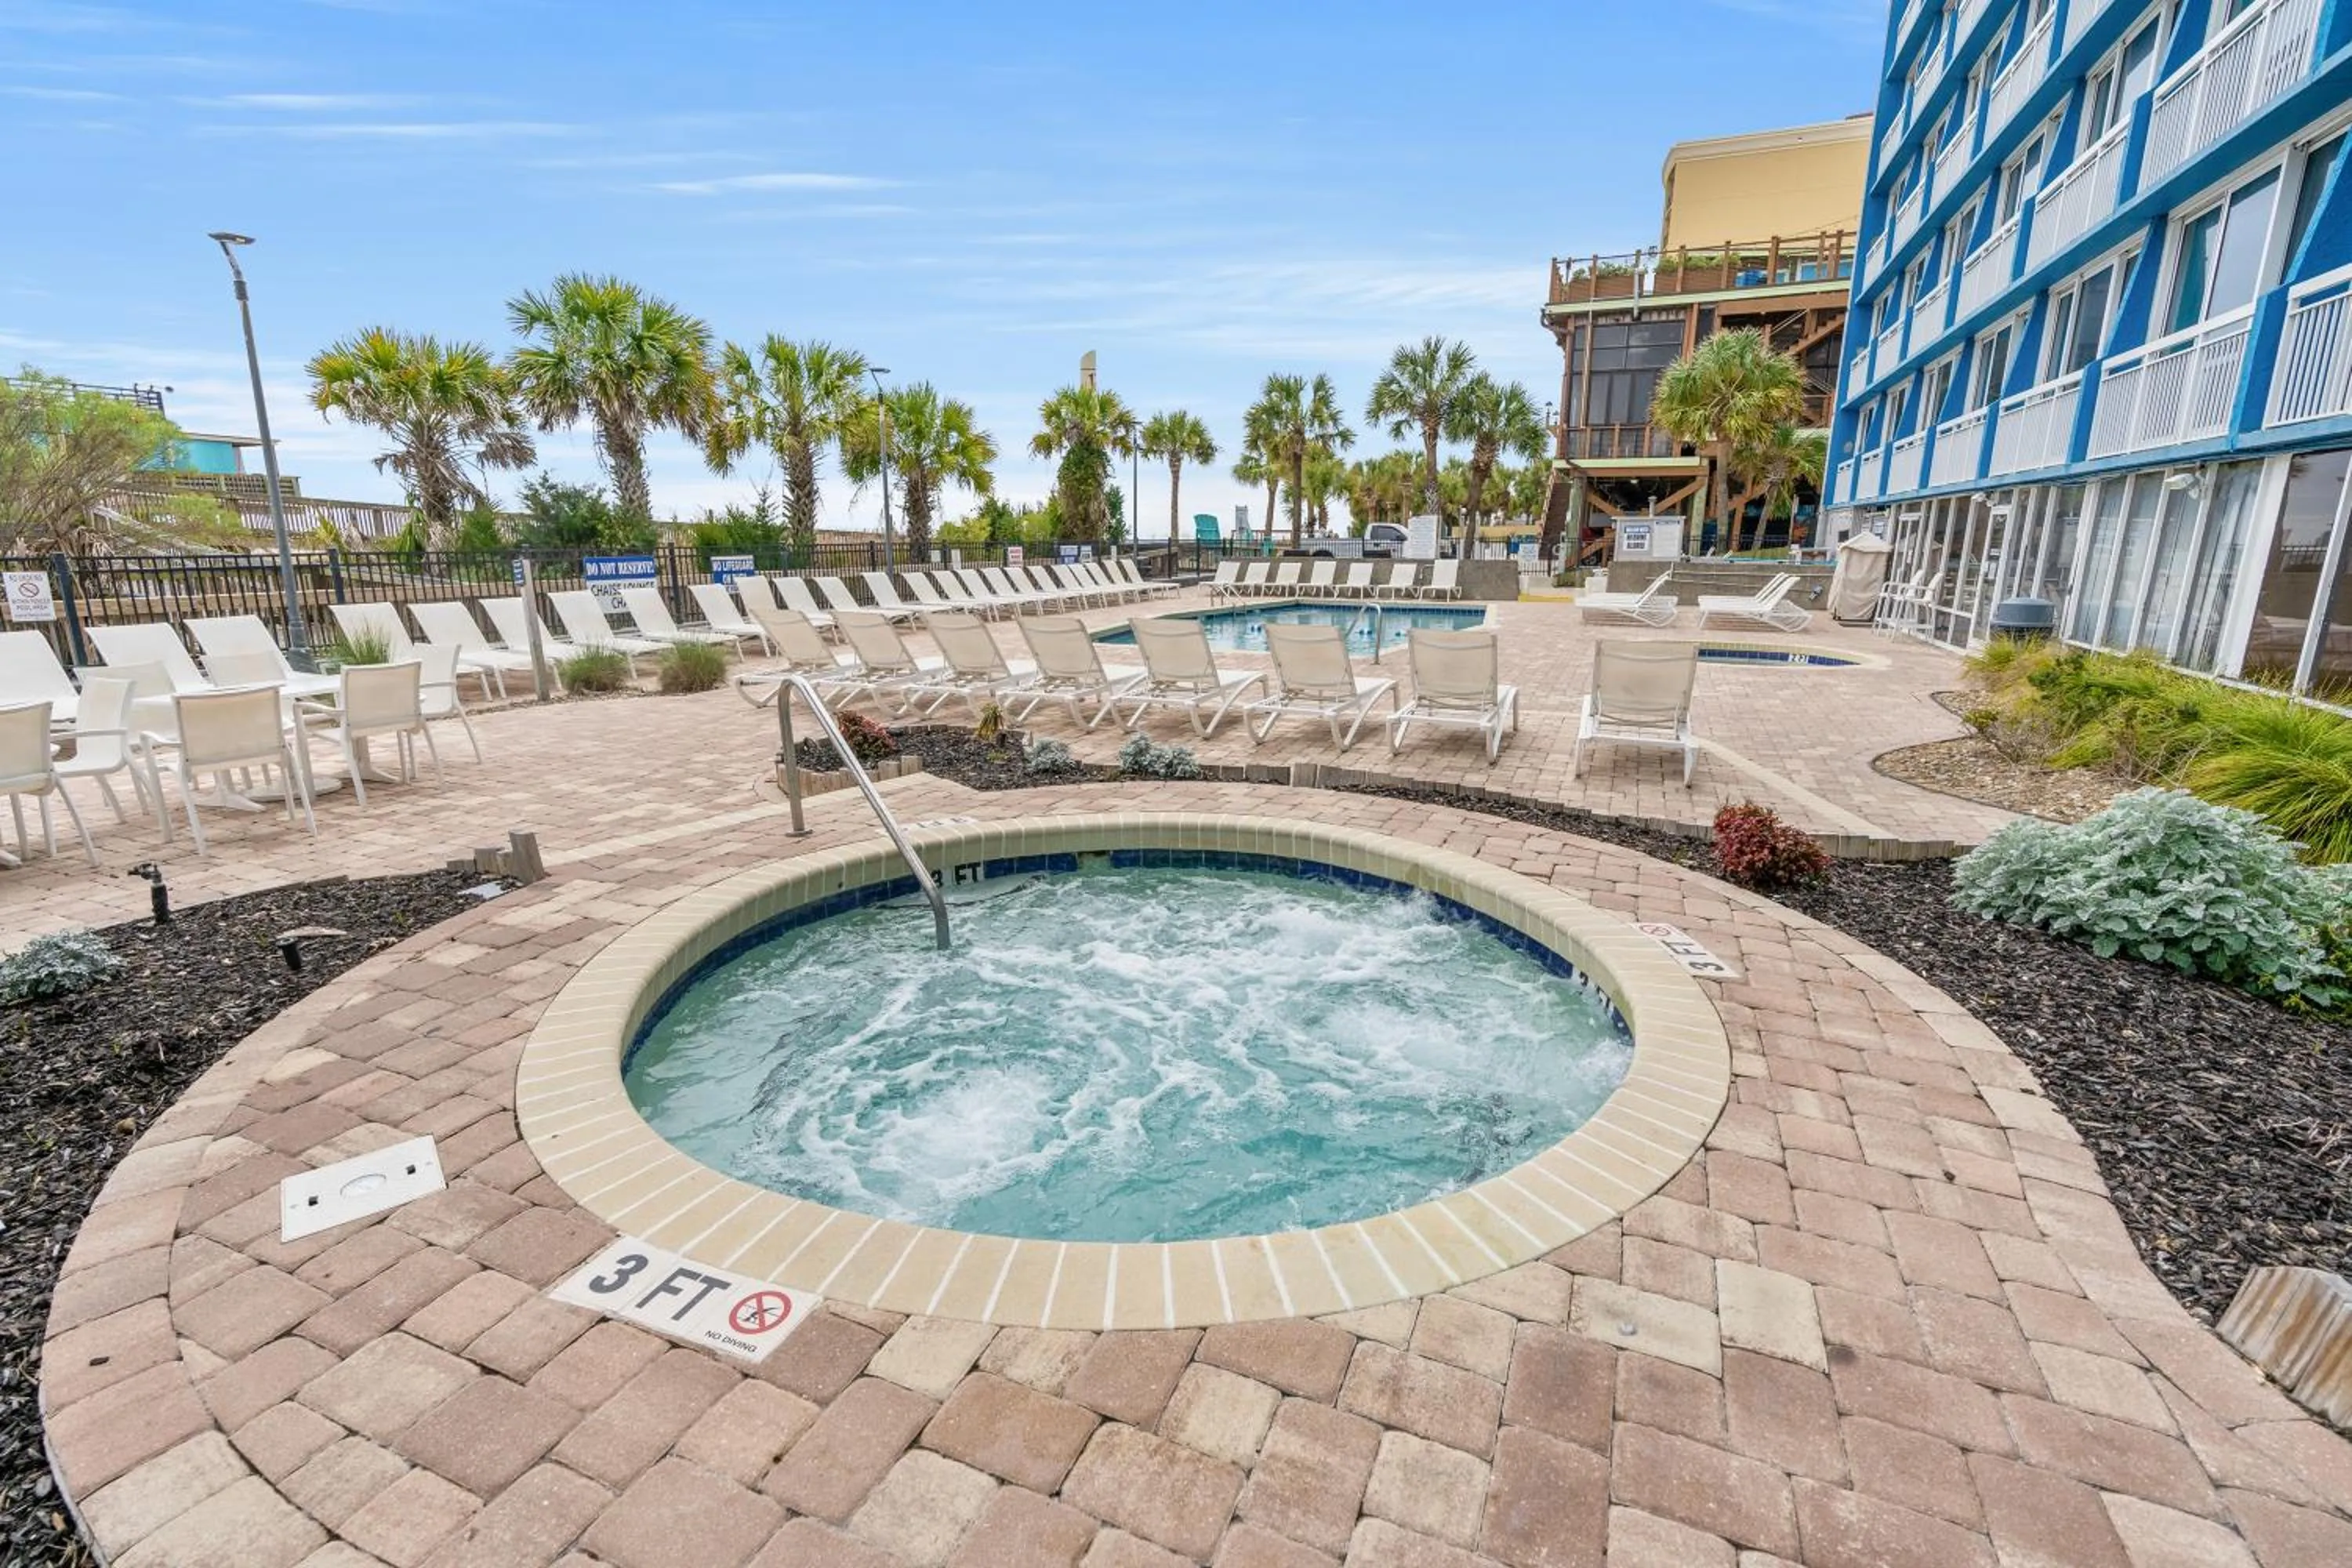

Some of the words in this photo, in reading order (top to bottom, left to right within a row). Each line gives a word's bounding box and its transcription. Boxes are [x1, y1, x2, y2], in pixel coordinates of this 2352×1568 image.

[586, 562, 598, 575] DO
[600, 562, 616, 575] NOT
[955, 862, 980, 885] FT
[1661, 939, 1707, 956] FT
[1689, 961, 1725, 971] 3
[589, 1254, 649, 1294] 3
[635, 1267, 731, 1322] FT
[705, 1330, 722, 1341] NO
[722, 1335, 758, 1352] DIVING
